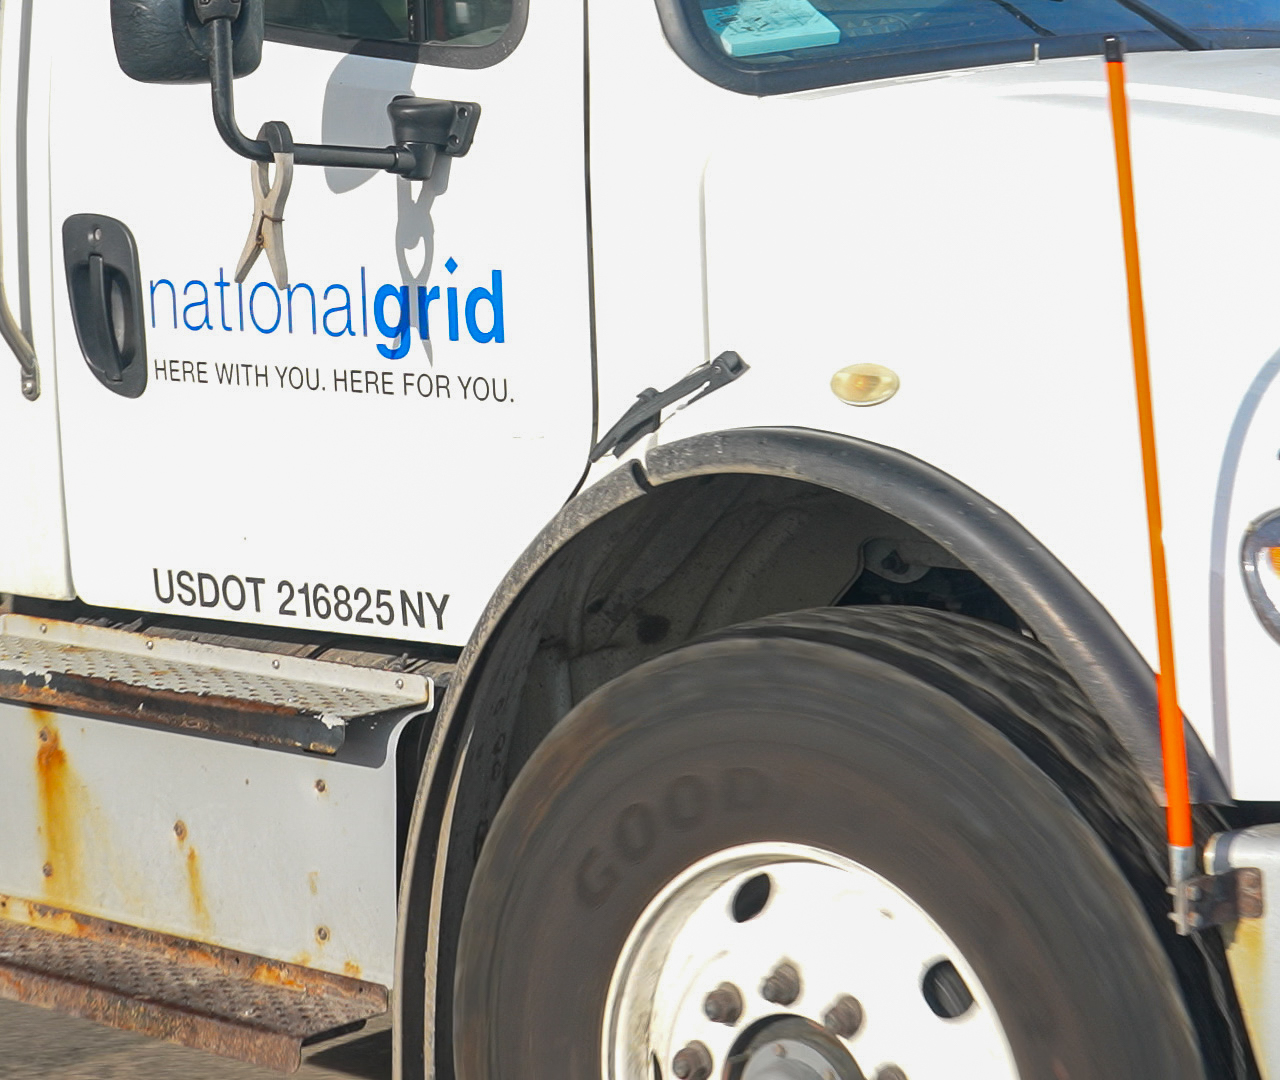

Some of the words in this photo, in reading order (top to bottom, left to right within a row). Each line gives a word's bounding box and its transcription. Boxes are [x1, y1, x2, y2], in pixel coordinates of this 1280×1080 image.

[154, 358, 209, 384] HERE
[215, 362, 269, 388] WITH
[275, 366, 326, 392] YOU.
[333, 368, 395, 396] HERE
[403, 373, 451, 399] FOR
[458, 376, 515, 403] YOU.
[153, 567, 266, 613] USDOT
